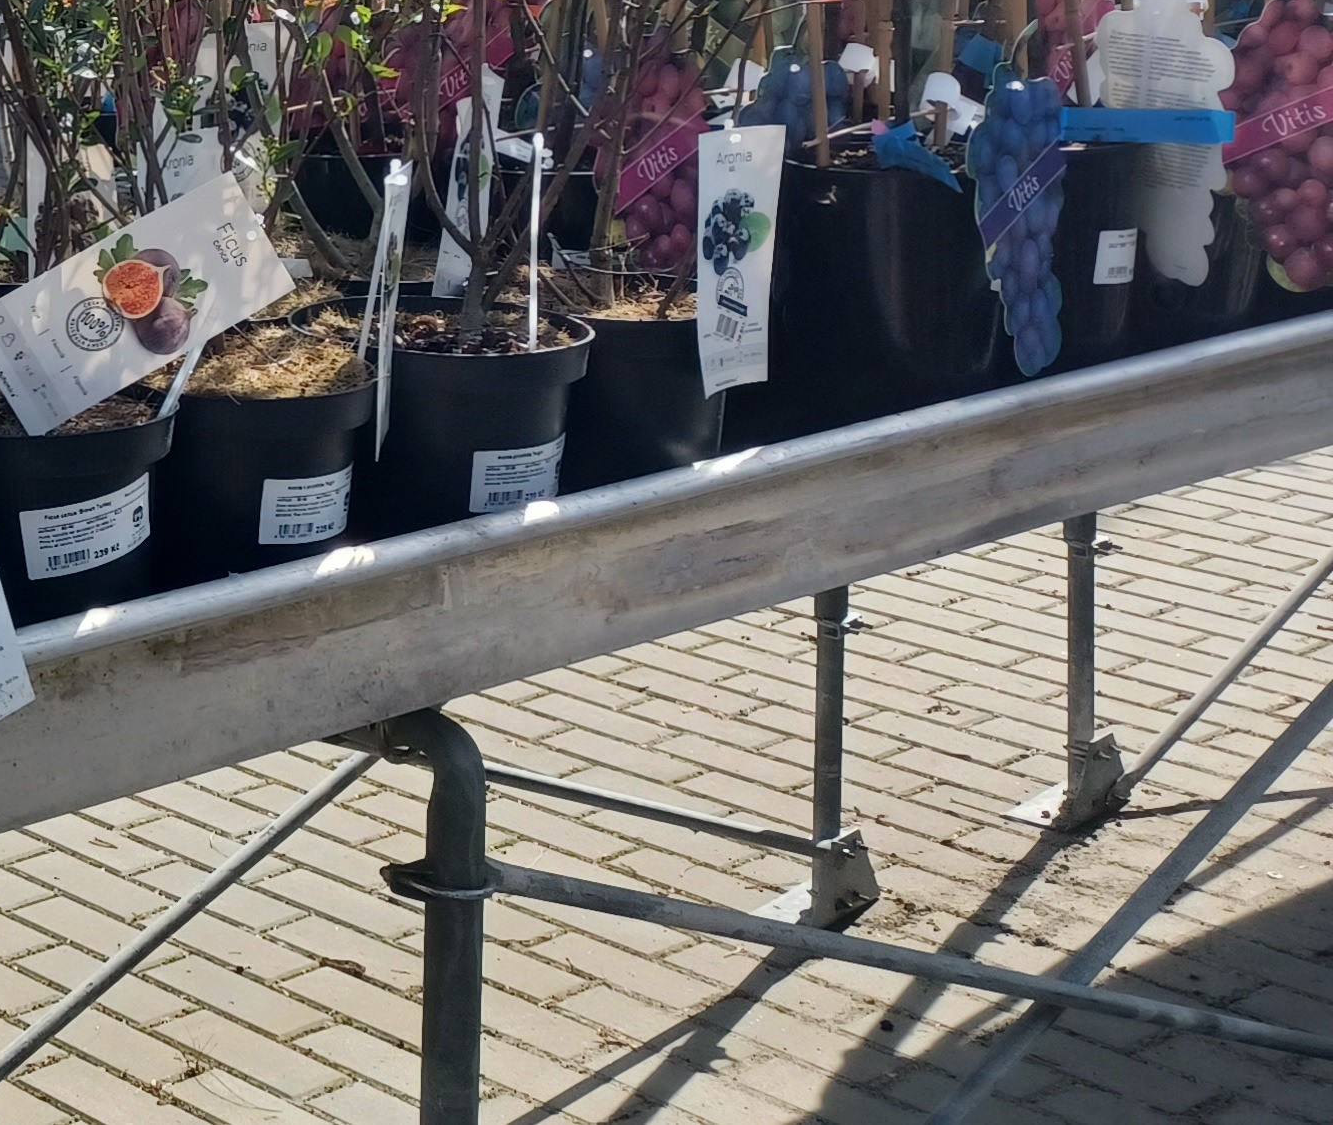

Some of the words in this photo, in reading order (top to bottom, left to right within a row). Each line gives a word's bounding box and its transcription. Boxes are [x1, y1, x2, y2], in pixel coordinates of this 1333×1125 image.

[1261, 103, 1327, 137] Vitis
[164, 154, 194, 171] ronia
[637, 145, 678, 181] Vitis
[717, 149, 753, 166] Aronia
[1008, 175, 1040, 212] Vitis
[213, 240, 229, 263] carica
[216, 222, 247, 267] Ficus
[80, 312, 110, 338] 100%
[94, 547, 108, 559] 239
[111, 542, 120, 553] Kč
